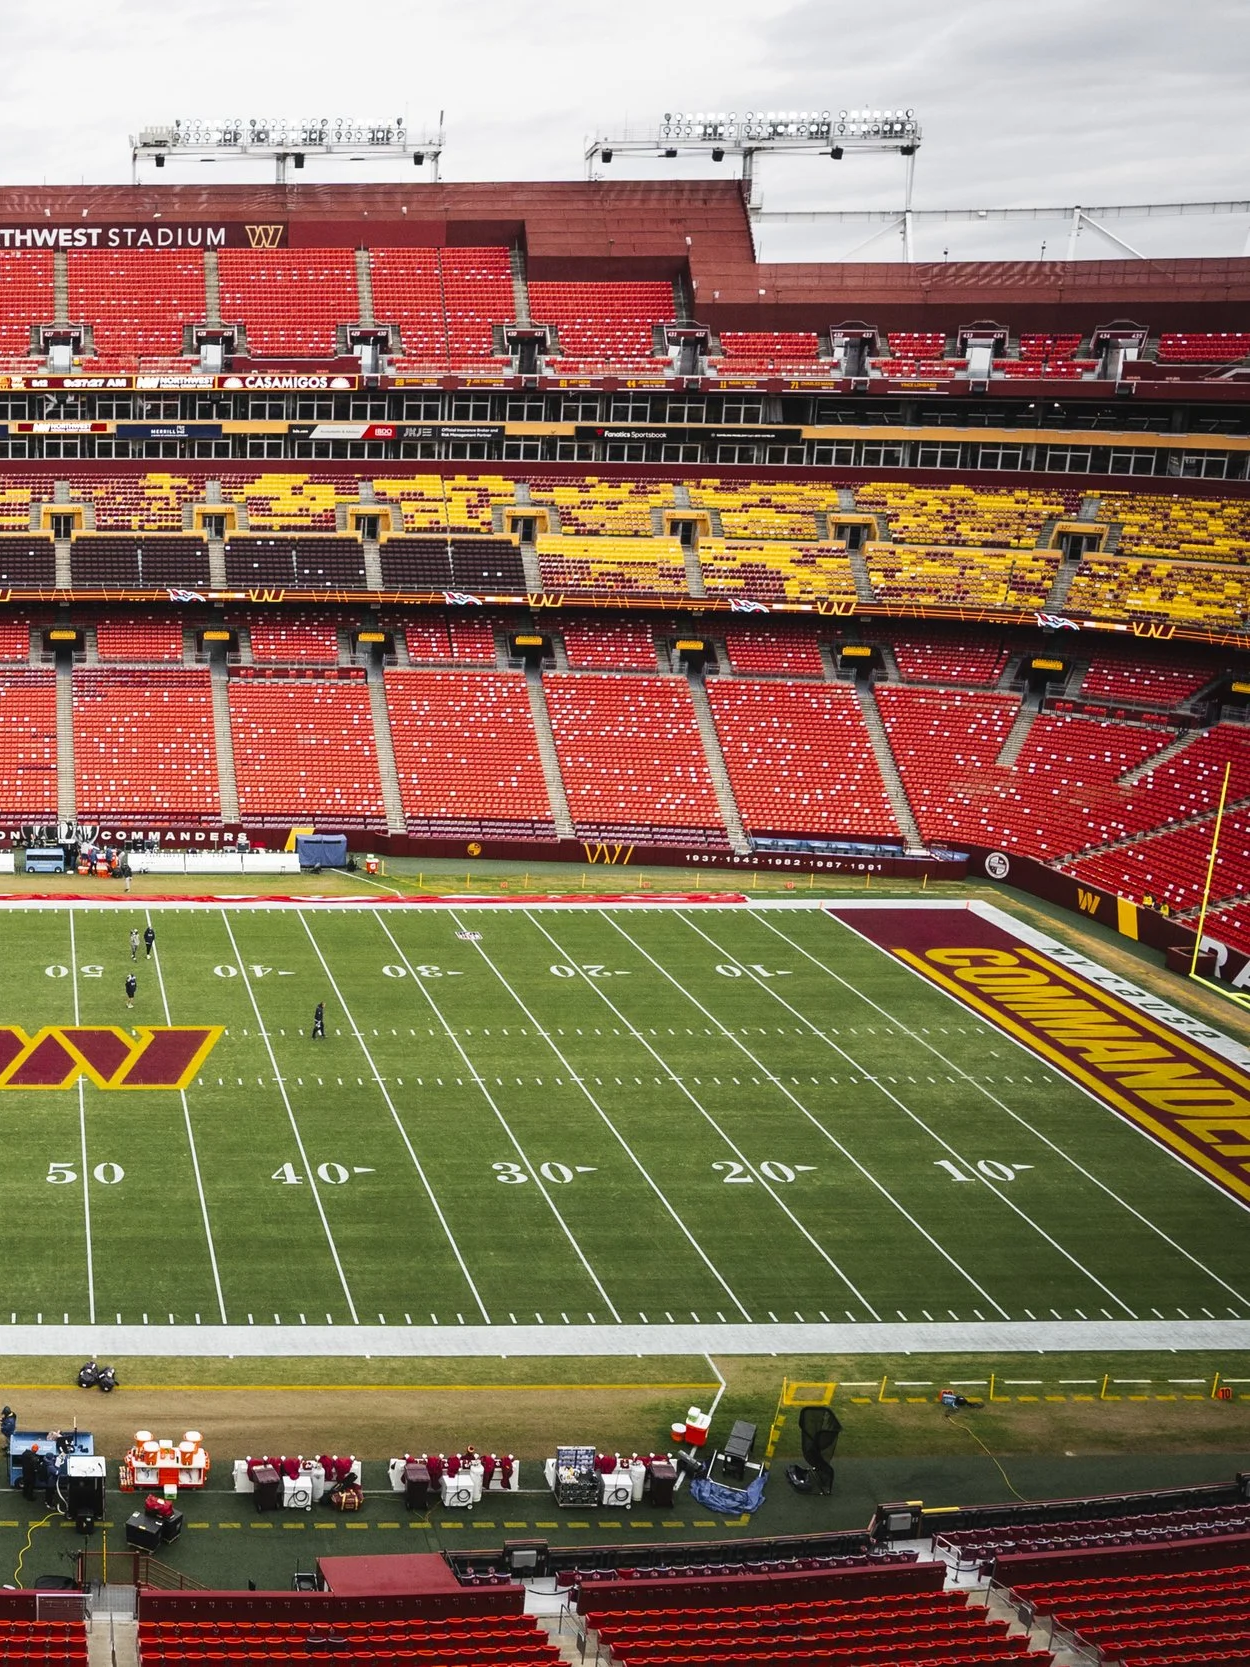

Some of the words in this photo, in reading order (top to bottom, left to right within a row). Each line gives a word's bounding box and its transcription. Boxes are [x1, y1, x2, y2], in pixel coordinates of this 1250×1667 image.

[108, 228, 225, 247] STADIUM
[106, 379, 126, 387] AM
[245, 376, 327, 388] CASAMIGOS
[101, 831, 248, 841] COMMANDERS
[924, 947, 1250, 1178] COMMANDE
[46, 1162, 125, 1184] 50
[272, 1162, 350, 1184] 40
[492, 1161, 574, 1184] 30
[712, 1161, 796, 1183] 20
[934, 1159, 1015, 1181] 10
[1221, 1388, 1231, 1399] 10
